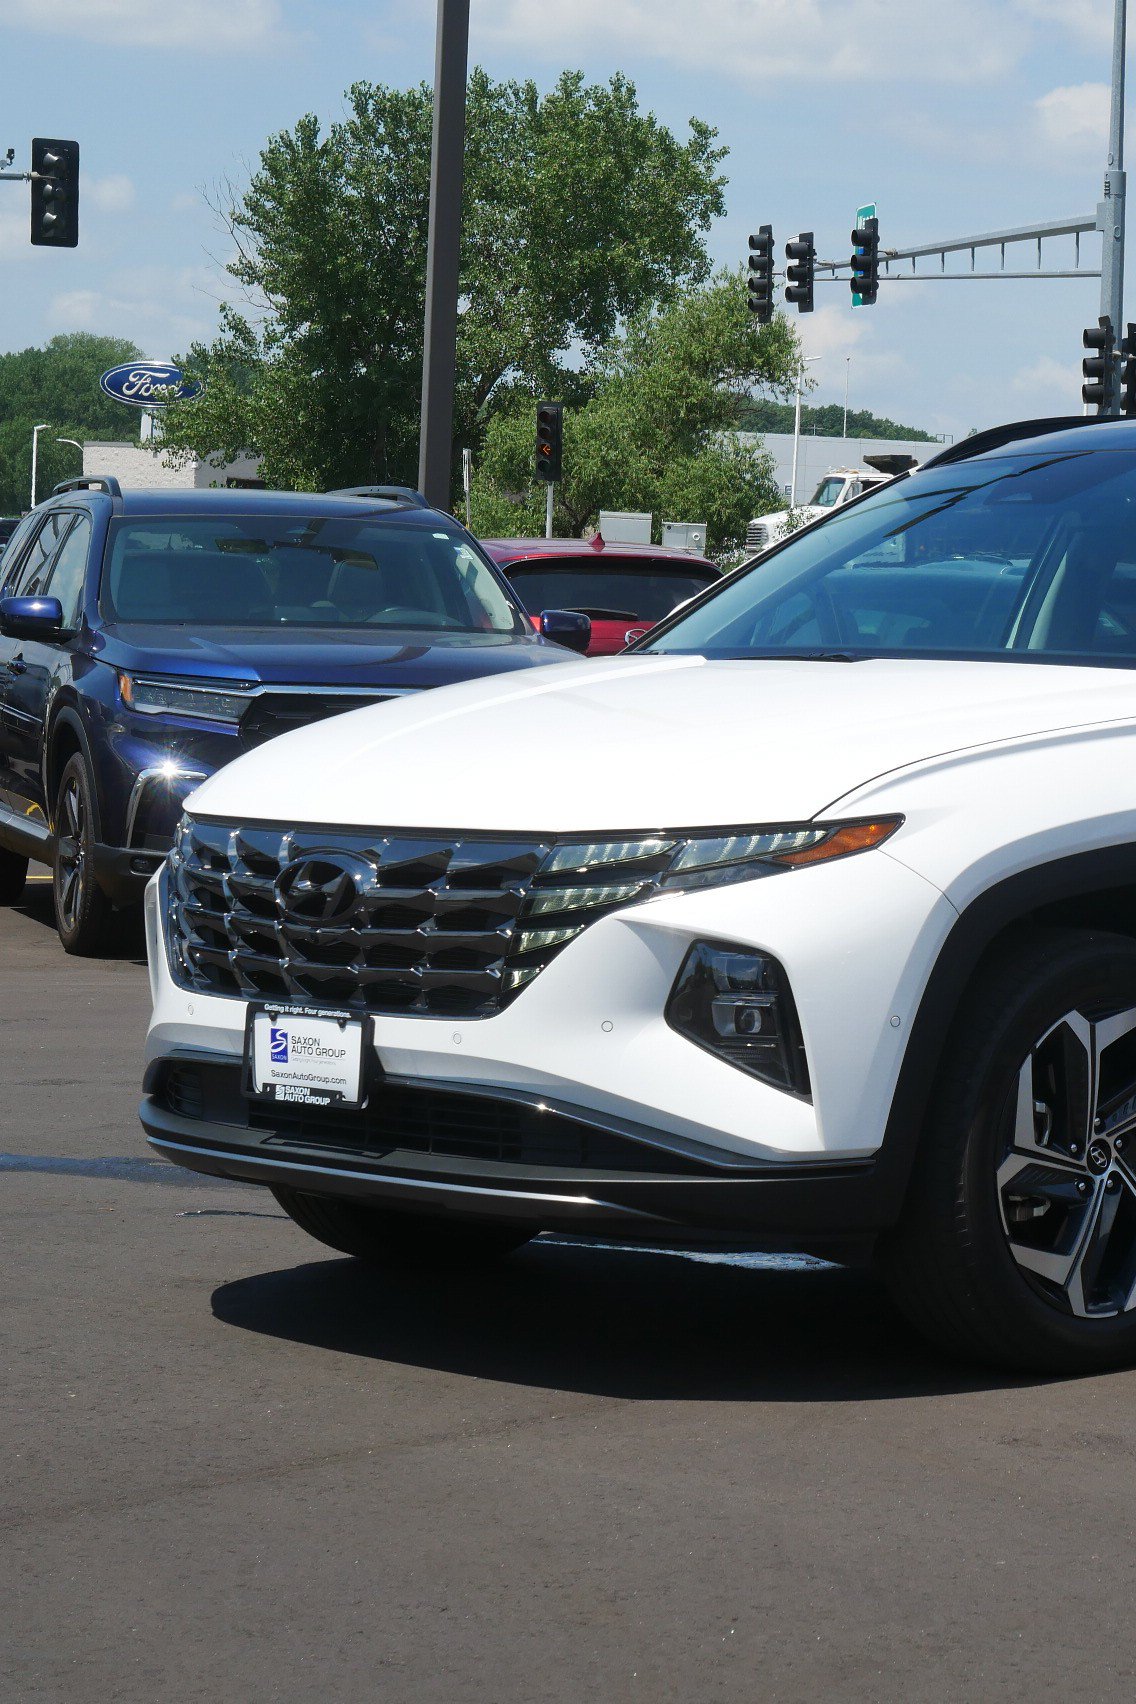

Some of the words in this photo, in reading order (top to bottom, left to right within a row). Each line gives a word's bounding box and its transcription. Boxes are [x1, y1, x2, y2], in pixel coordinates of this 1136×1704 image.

[122, 370, 183, 397] Ford
[264, 1004, 284, 1013] Getting
[291, 1035, 320, 1047] SAXON
[271, 1053, 287, 1061] SAXON
[291, 1045, 314, 1056] AUTO
[315, 1047, 346, 1058] GROUP
[271, 1069, 346, 1084] SaxonAutoGroup.com
[285, 1085, 310, 1096] SAXON
[284, 1093, 304, 1103] AUTO
[304, 1096, 331, 1106] GROUP
